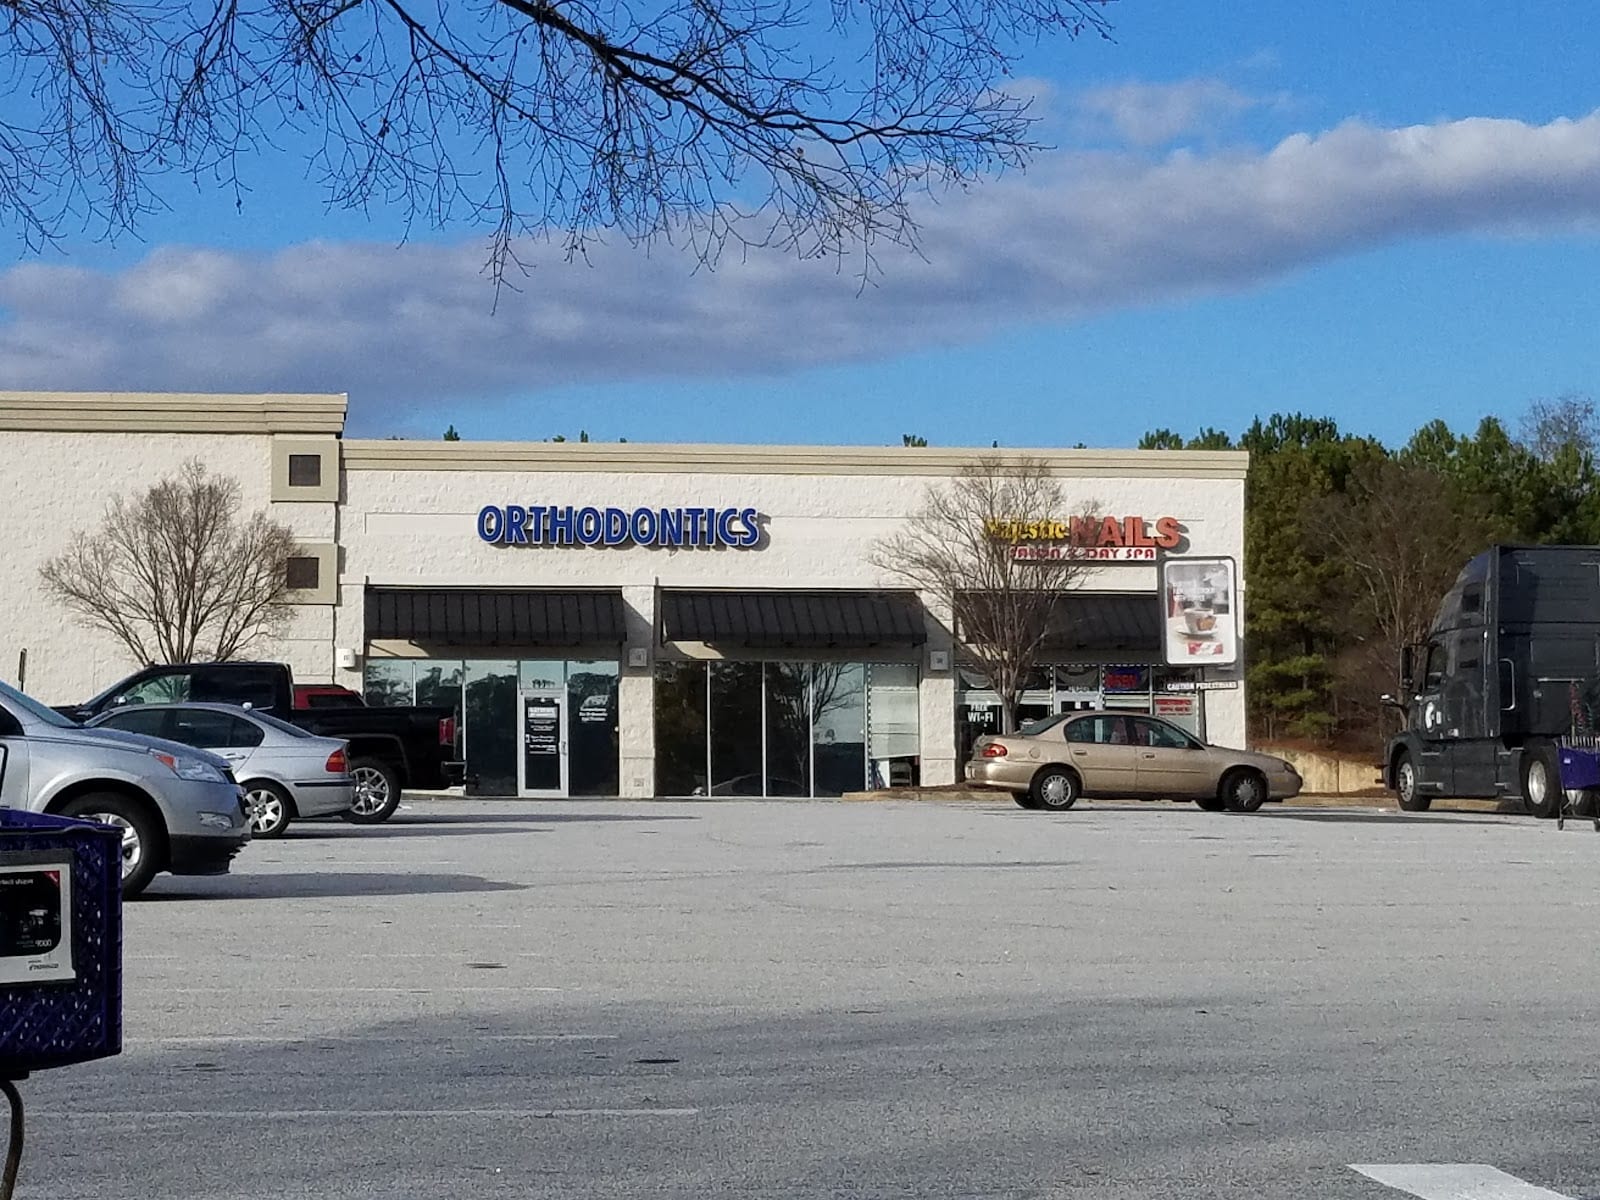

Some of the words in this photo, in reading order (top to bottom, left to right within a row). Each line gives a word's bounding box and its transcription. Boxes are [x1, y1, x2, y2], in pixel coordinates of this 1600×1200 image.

[478, 505, 760, 545] ORTHODONTICS
[1070, 516, 1180, 548] NAILS
[1086, 549, 1119, 559] DAY
[1126, 549, 1154, 559] SPA
